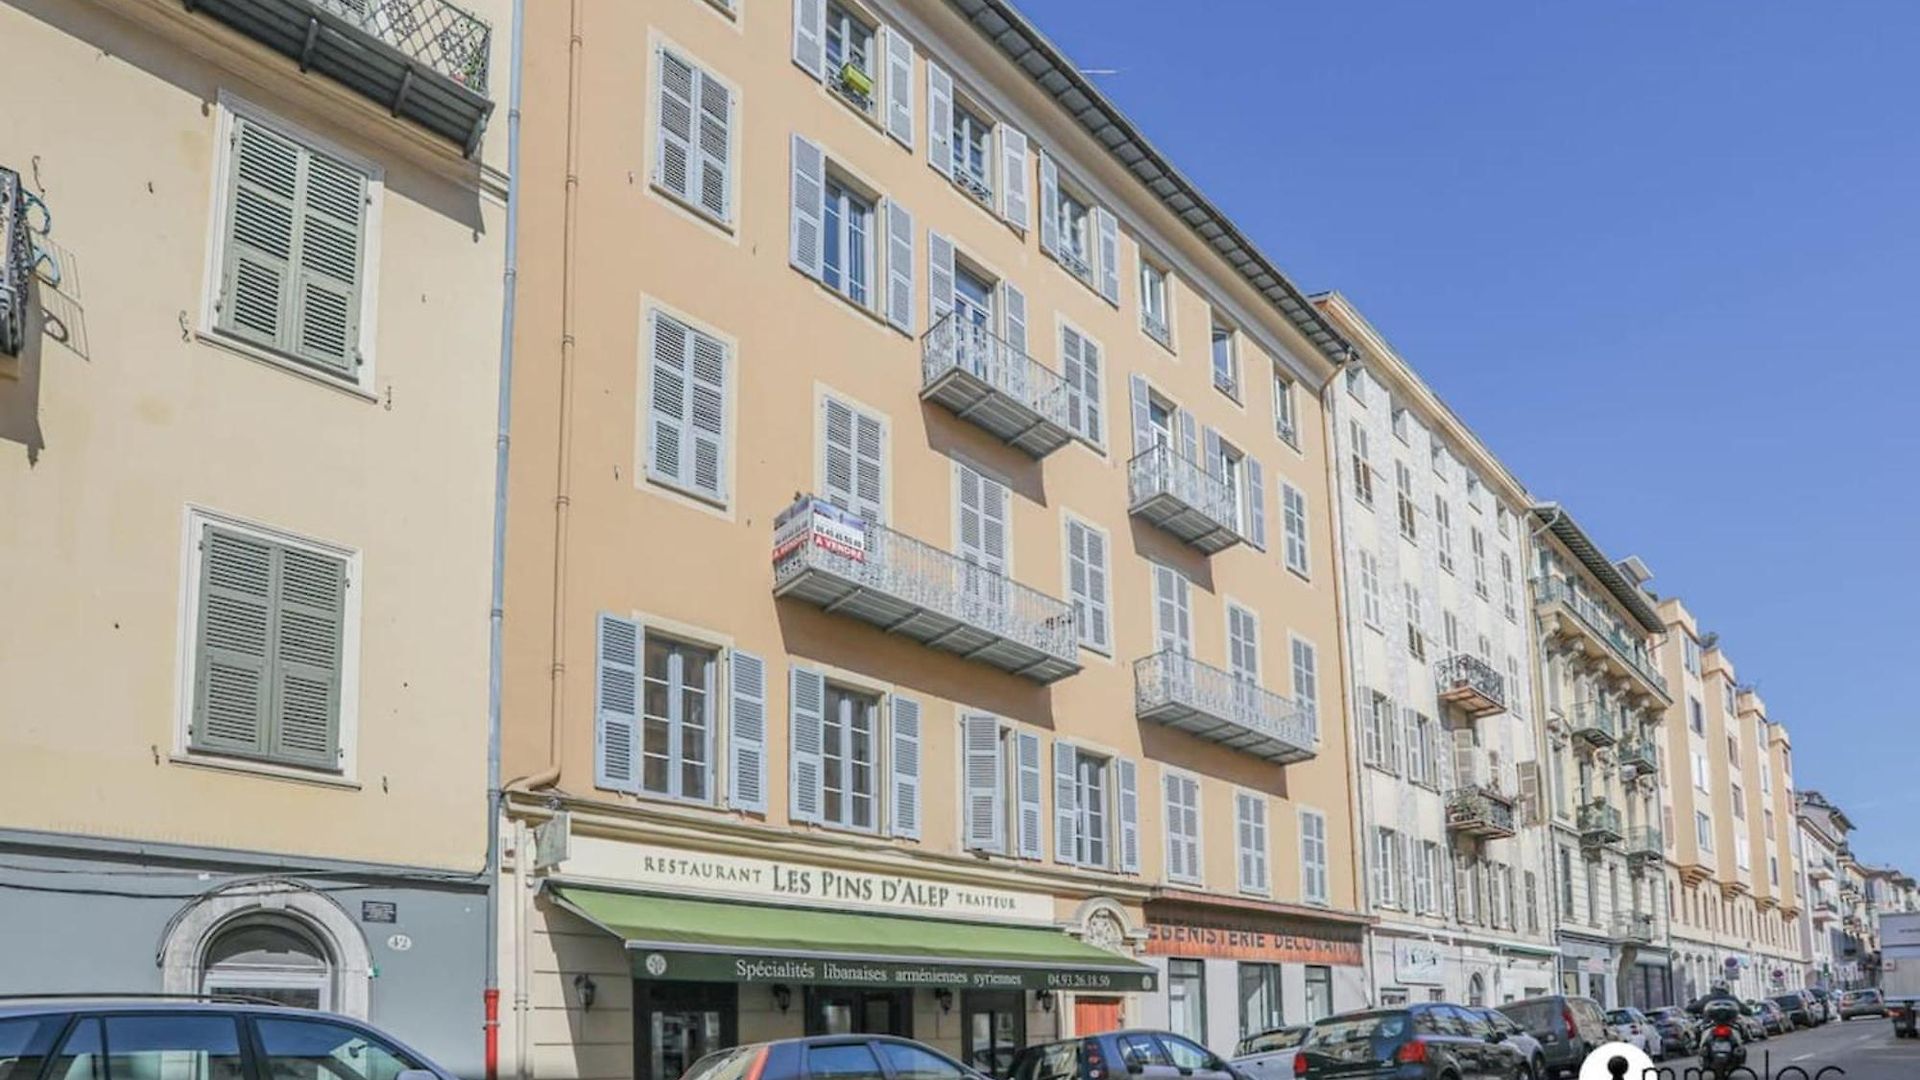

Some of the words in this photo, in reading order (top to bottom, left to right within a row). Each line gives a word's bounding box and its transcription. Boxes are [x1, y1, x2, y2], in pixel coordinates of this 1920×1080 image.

[644, 856, 762, 884] RESTAURANT
[773, 865, 812, 895] LES
[822, 871, 873, 901] PINS
[882, 878, 949, 908] D'ALEP
[957, 892, 1016, 910] TRAITEUR
[391, 936, 408, 948] 42
[1274, 928, 1361, 954] DECORATI
[736, 959, 815, 981] Spécialités
[823, 962, 888, 982] libanaises
[895, 968, 968, 985] arméniennes
[973, 970, 1022, 987] syriennes
